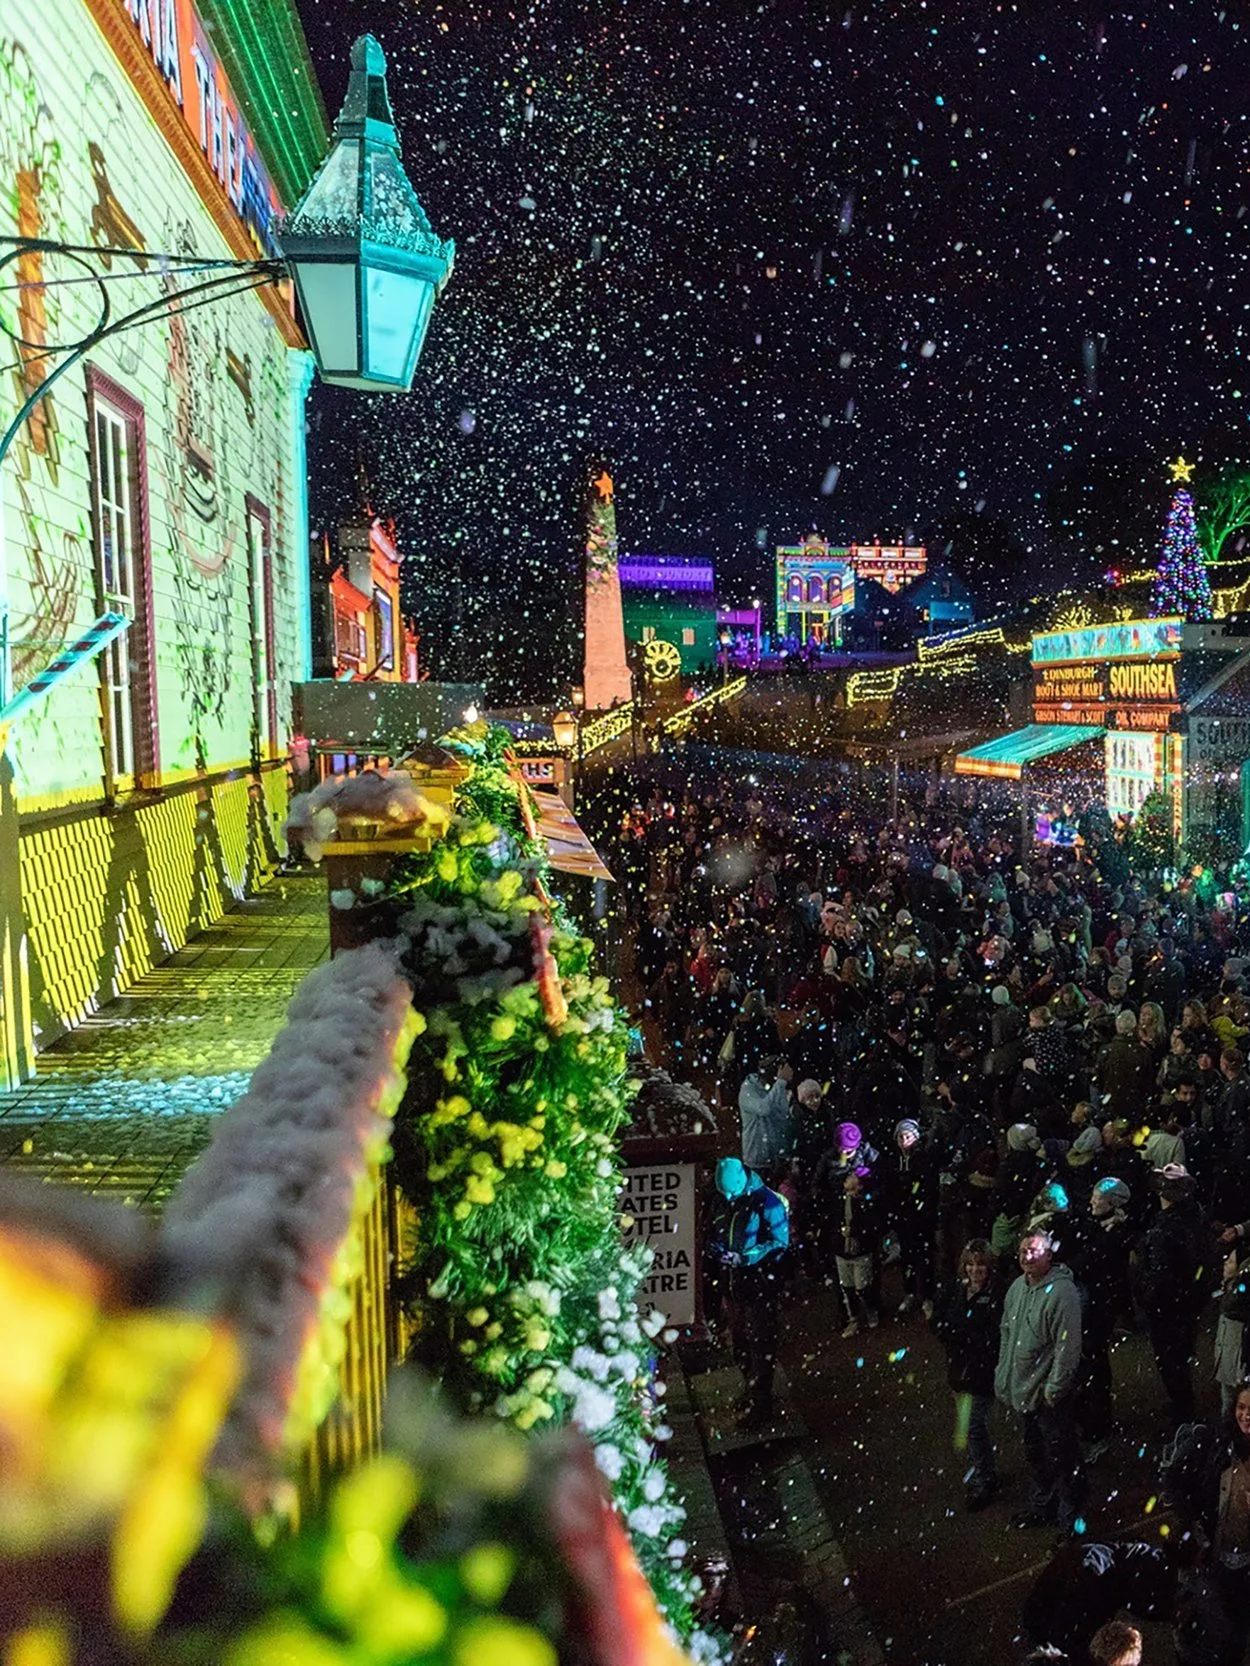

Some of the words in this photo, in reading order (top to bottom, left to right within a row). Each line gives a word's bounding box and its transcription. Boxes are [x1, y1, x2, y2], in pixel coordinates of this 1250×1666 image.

[1043, 666, 1095, 681] EDINBURGH
[1109, 663, 1177, 698] SOUTHSEA
[1061, 683, 1081, 697] SHOE
[1082, 682, 1104, 696] MART
[1130, 710, 1170, 727] COMPANY
[627, 1172, 682, 1193] ITED
[621, 1193, 679, 1213] ATES
[618, 1215, 675, 1236] TEL
[652, 1250, 691, 1270] RIA
[643, 1273, 688, 1294] TRE
